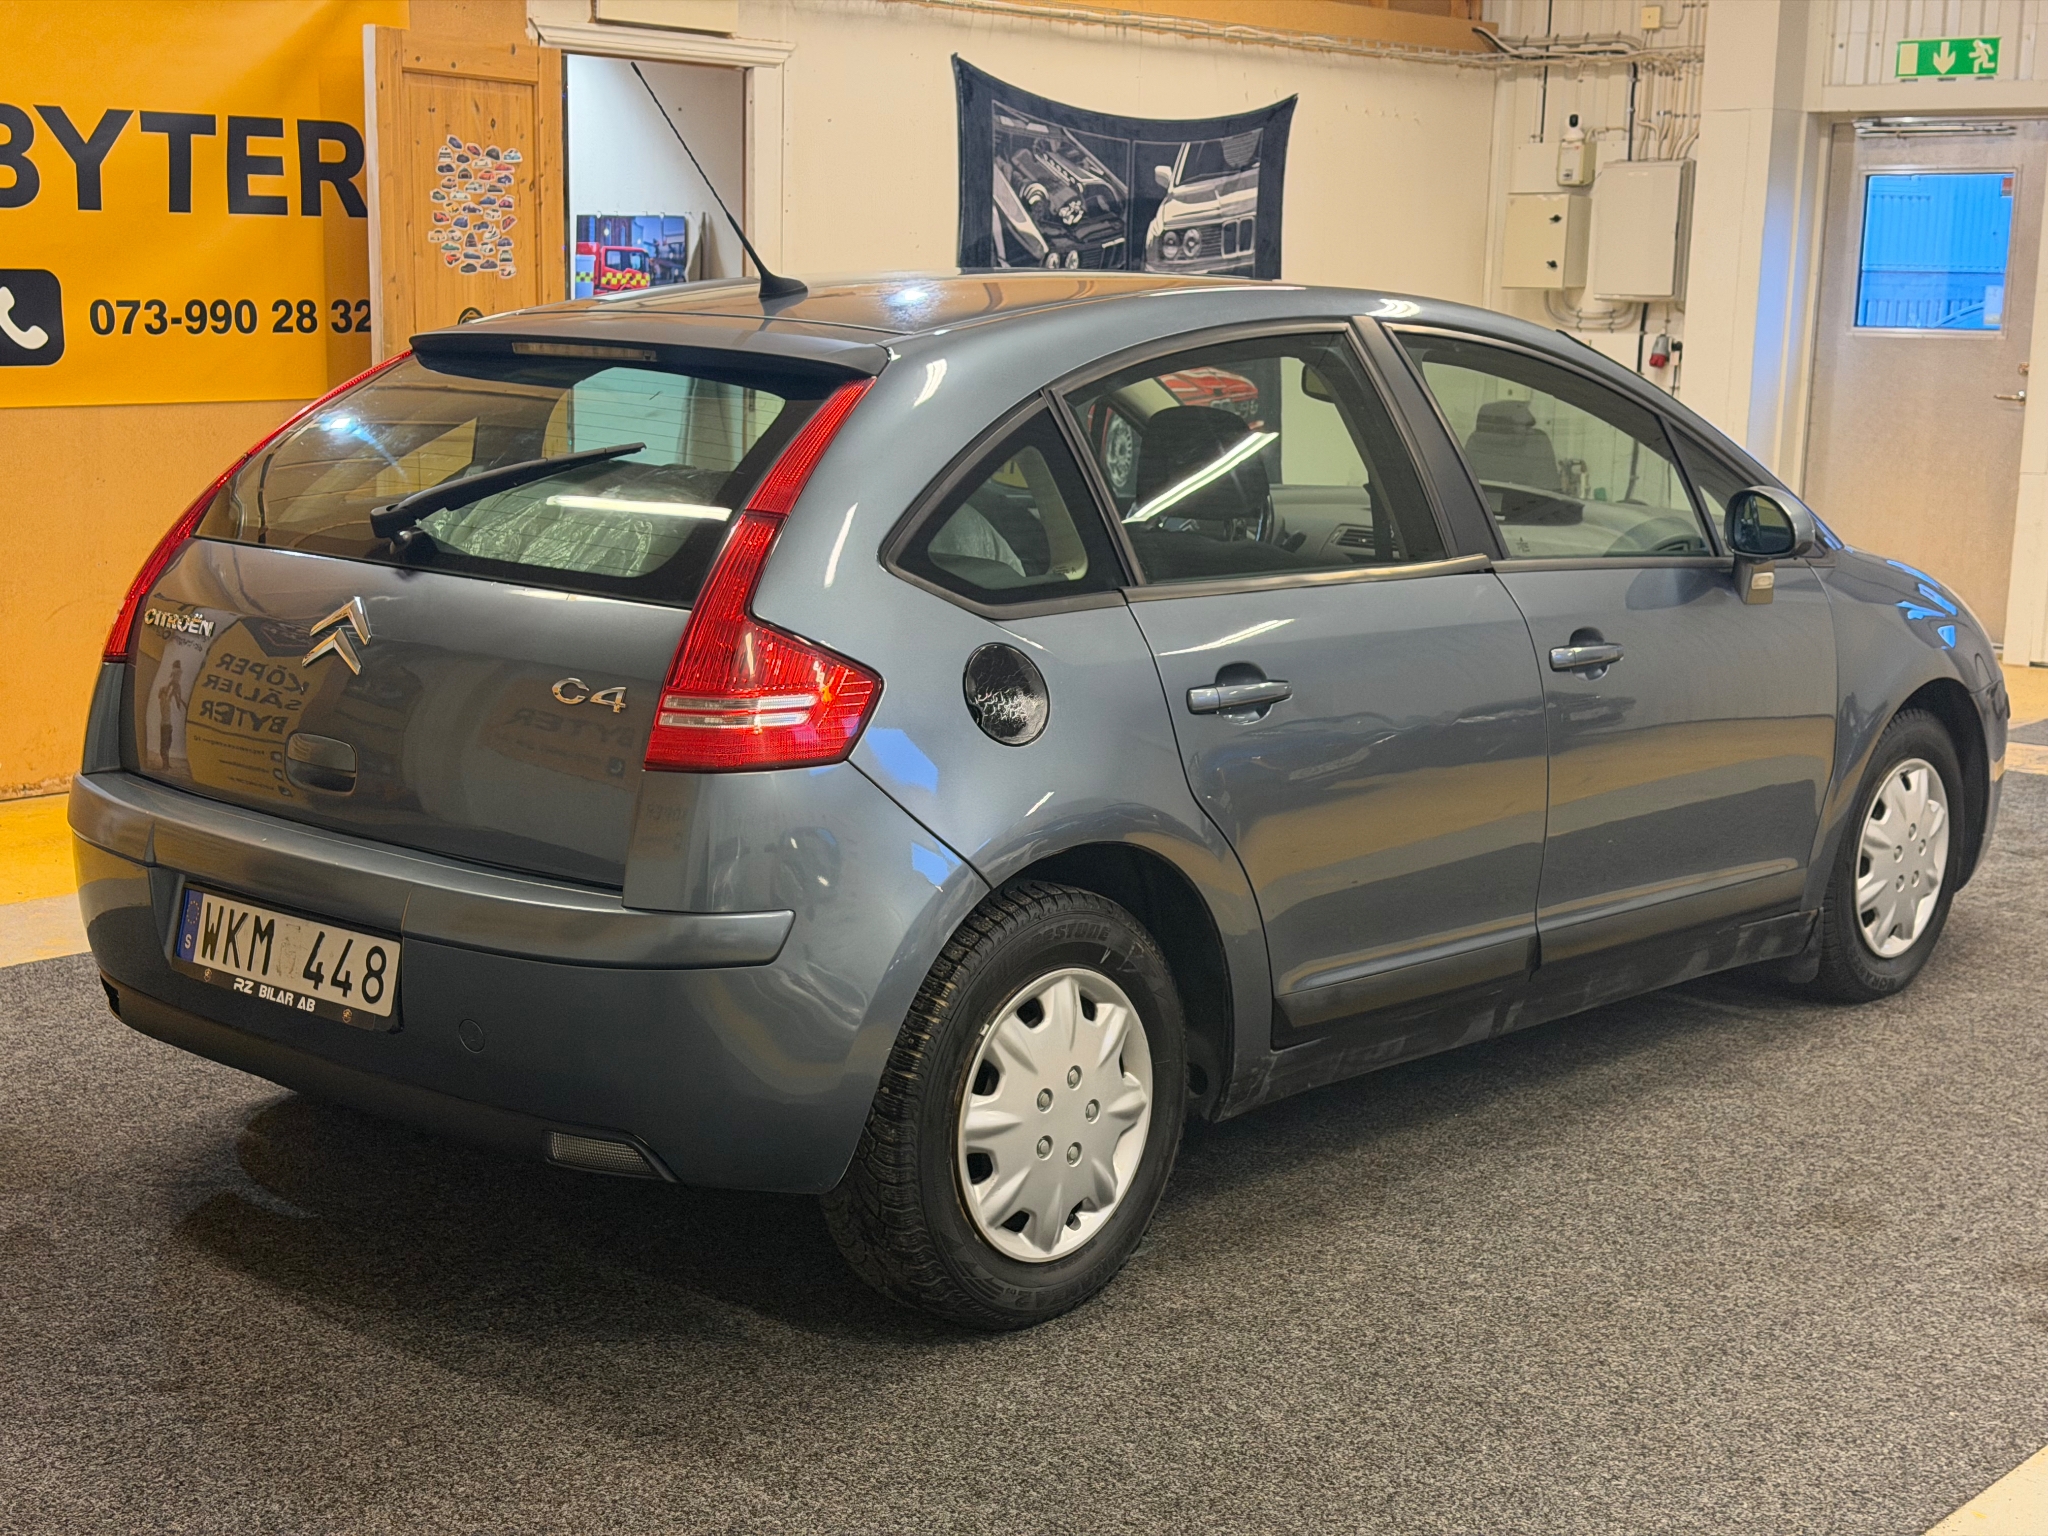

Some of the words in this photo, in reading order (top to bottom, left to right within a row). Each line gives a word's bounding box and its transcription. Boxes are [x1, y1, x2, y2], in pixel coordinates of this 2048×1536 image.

[0, 103, 369, 218] BYTER
[89, 299, 258, 336] 073-990
[271, 299, 318, 334] 28
[330, 299, 372, 334] 32
[144, 608, 216, 638] CITROËN
[552, 677, 627, 714] C4
[184, 933, 193, 950] S
[201, 902, 275, 976] WKM
[302, 931, 387, 1004] 448
[258, 984, 294, 1007] BILAR
[296, 998, 316, 1012] AB
